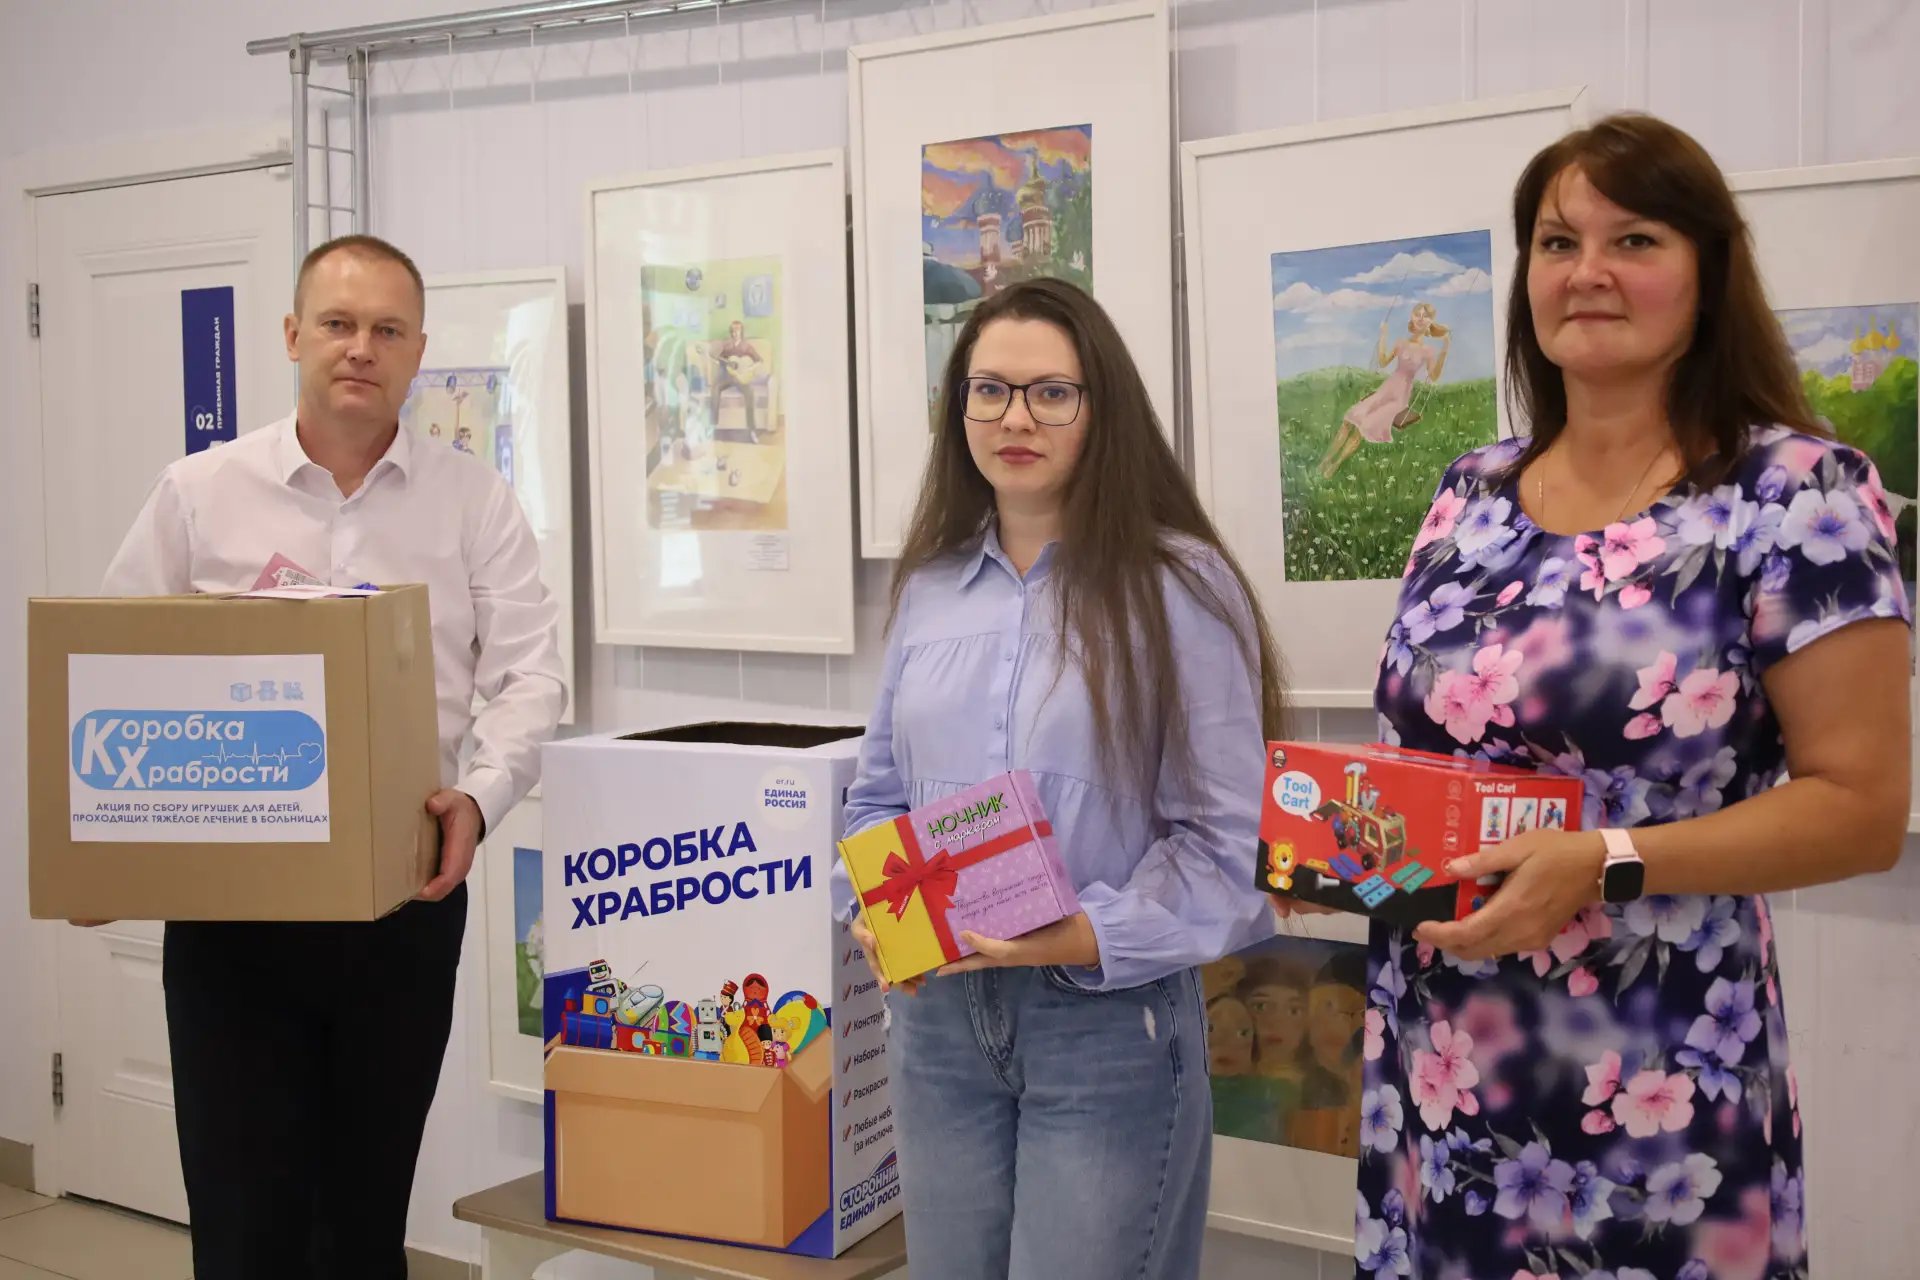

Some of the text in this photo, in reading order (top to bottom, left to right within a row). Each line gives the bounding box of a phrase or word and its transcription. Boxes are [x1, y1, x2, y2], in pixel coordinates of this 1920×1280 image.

[213, 316, 221, 369] ГРАЖДАН
[195, 413, 214, 430] 02
[80, 714, 245, 776] Коробка
[113, 746, 289, 789] Храбрости
[764, 788, 806, 798] ЕДИНАЯ
[1283, 776, 1313, 795] Tool
[1474, 782, 1517, 794] Tool Cart
[96, 802, 303, 813] АКЦИЯ ПО СБОРУ ИГРУШЕК ДЛЯ ДЕТЕЙ,
[764, 798, 806, 809] РОССИЯ
[1281, 793, 1310, 810] Cart
[73, 813, 328, 824] ПРОХОДЯЩИХ ТЯЖЁЛОЕ ЛЕЧЕНИЕ В БОЛЬНИЦАХ
[927, 792, 1009, 839] НОЧНИК
[946, 815, 1001, 852] маркером
[564, 821, 757, 887] КОРОБКА
[571, 855, 812, 930] ХРАБРОСТИ
[853, 949, 865, 961] Па
[853, 1047, 880, 1066] Наборы
[853, 1076, 889, 1100] Раскраски
[853, 1116, 878, 1135] Любые
[840, 1162, 899, 1212] СТОРОННИ
[840, 1196, 876, 1231] ЕДИНОЙ
